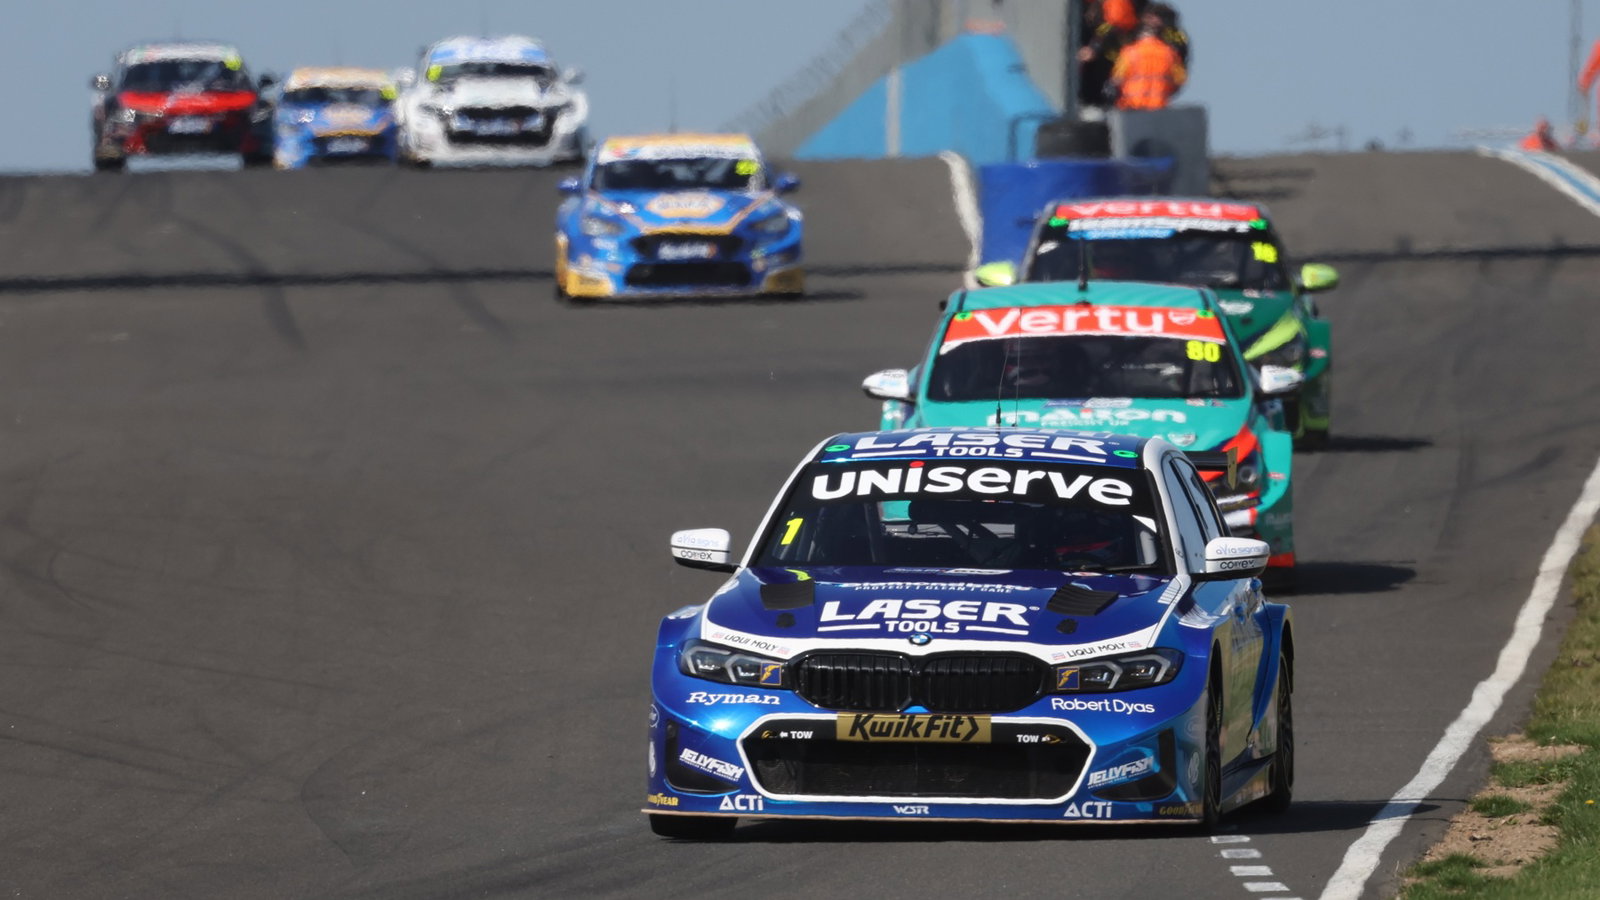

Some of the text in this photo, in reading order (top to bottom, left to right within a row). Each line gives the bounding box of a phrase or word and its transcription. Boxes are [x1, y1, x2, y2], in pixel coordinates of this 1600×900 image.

[1186, 340, 1220, 363] 80
[933, 447, 1024, 458] TOOLS
[781, 518, 803, 545] 1
[885, 620, 960, 633] TOOLS
[723, 633, 778, 652] LIQUI MOLY
[1066, 641, 1127, 658] LIQUI MOLY
[686, 691, 781, 706] Ryman
[1051, 698, 1156, 715] Robert Dyas
[790, 730, 813, 740] TOW
[1017, 734, 1040, 743] TOW
[680, 748, 745, 779] JELLYFISH
[1087, 757, 1154, 786] JELLYFISH
